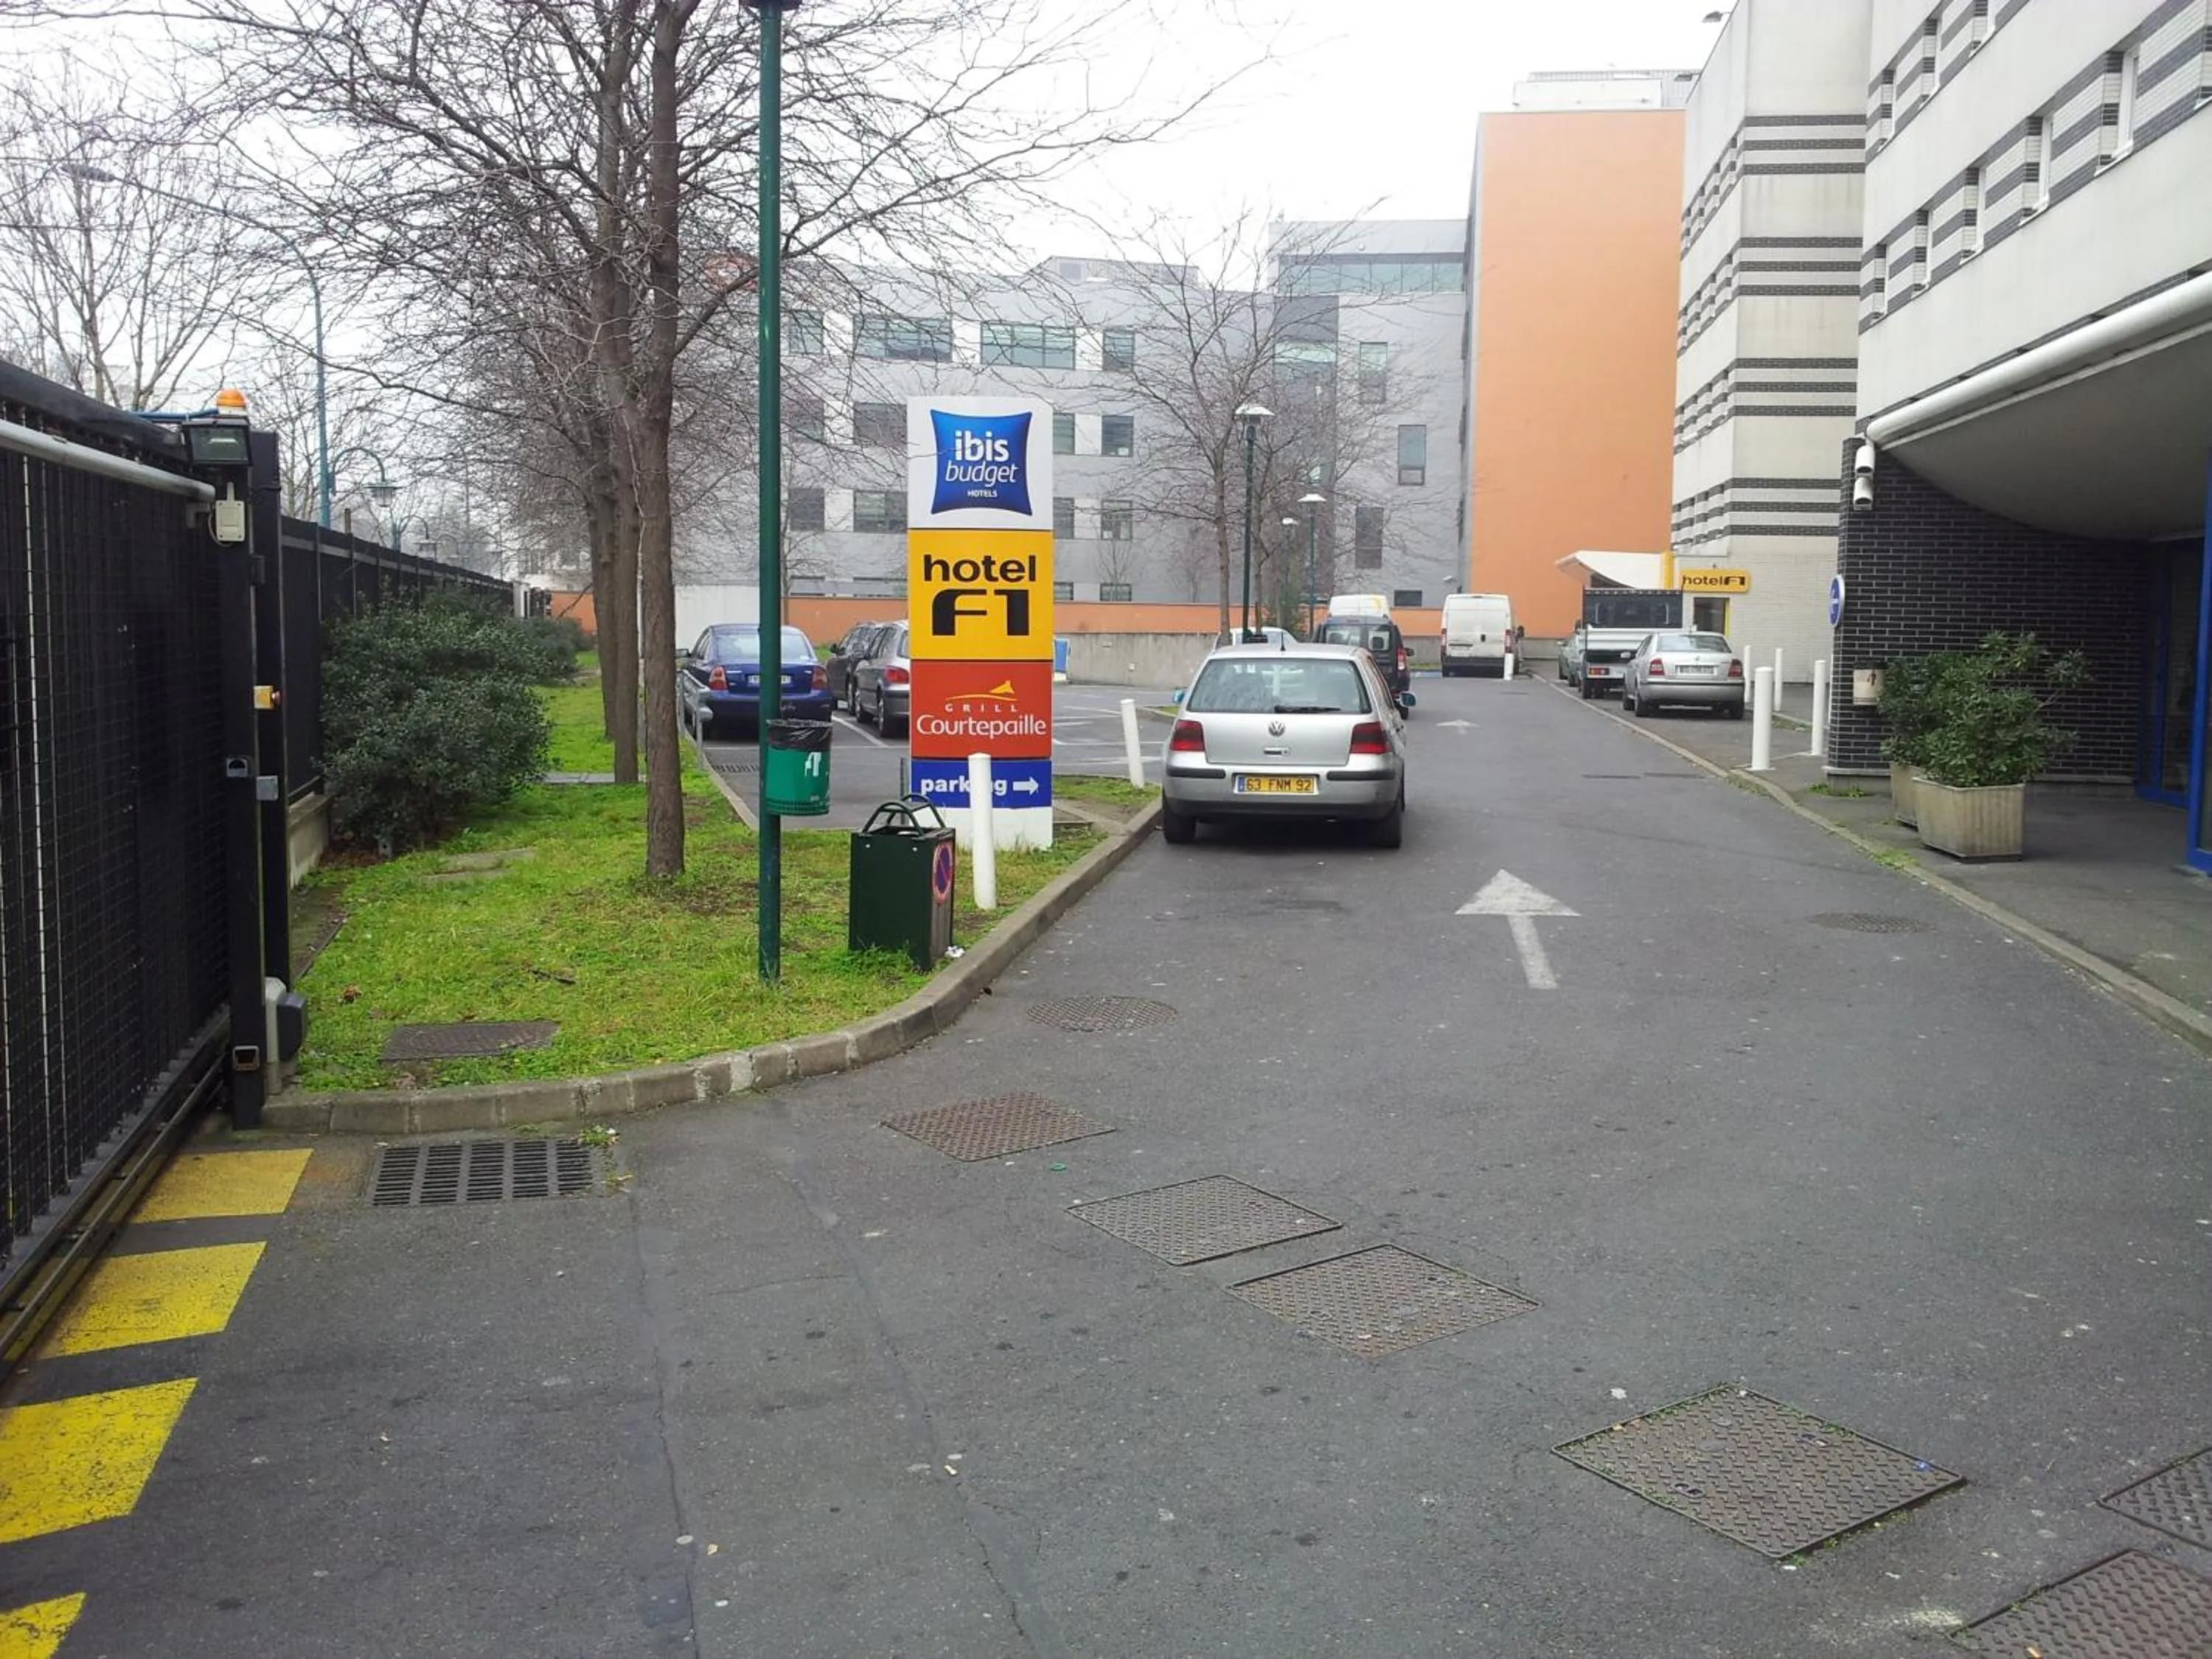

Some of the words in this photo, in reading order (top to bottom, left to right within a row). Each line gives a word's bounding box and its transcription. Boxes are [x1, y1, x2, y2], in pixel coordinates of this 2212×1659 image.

[955, 430, 1009, 462] ibis
[945, 460, 1019, 487] budget
[967, 490, 998, 498] HOTELS
[924, 554, 1036, 582] hotel
[932, 589, 1029, 636] F1
[945, 703, 1018, 712] GRILL
[917, 714, 1046, 739] Courtepaille
[921, 776, 1007, 796] parkg
[1246, 778, 1262, 791] 63
[1268, 778, 1291, 791] FNM
[1295, 779, 1311, 791] 92
